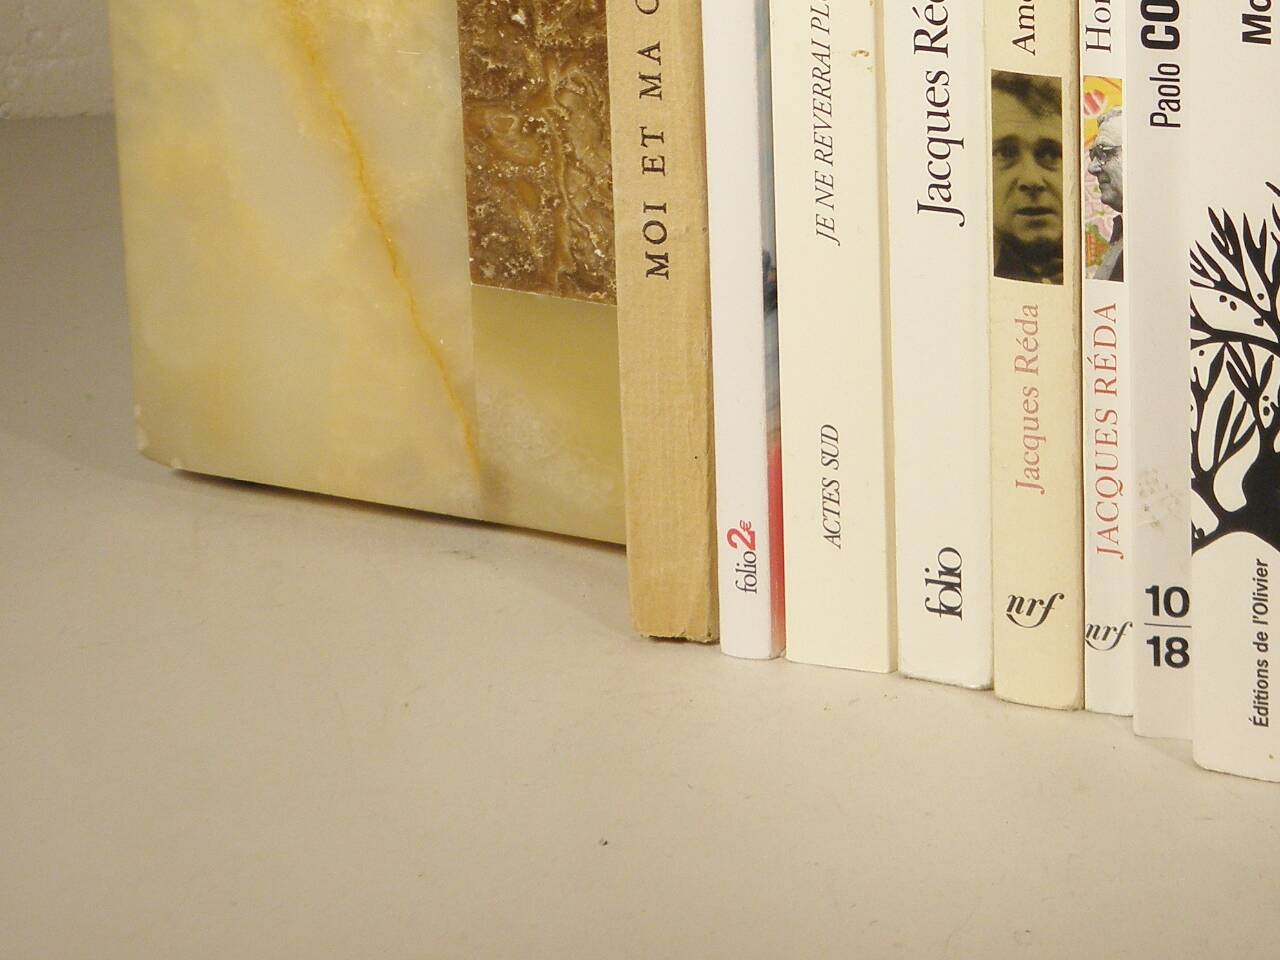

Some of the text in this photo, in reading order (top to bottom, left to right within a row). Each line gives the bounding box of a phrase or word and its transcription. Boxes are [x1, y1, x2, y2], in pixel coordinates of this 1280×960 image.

[636, 41, 663, 101] MA
[1150, 63, 1181, 129] Paolo
[808, 38, 834, 169] REVERRAI
[639, 126, 666, 177] ET
[916, 70, 966, 228] Jacques
[814, 170, 835, 210] NE
[642, 201, 670, 281] MOI
[815, 213, 841, 247] JE
[1014, 304, 1047, 496] Jacques Réda
[1086, 303, 1124, 560] JACQUES RÉDA
[820, 424, 841, 549] ACTES SUD
[924, 546, 963, 621] folio
[1006, 592, 1065, 629] nrf
[1145, 585, 1190, 619] 10
[1085, 621, 1133, 651] nrf
[1146, 635, 1190, 669] 18
[1252, 630, 1270, 650] de
[1248, 659, 1269, 728] Éditions
